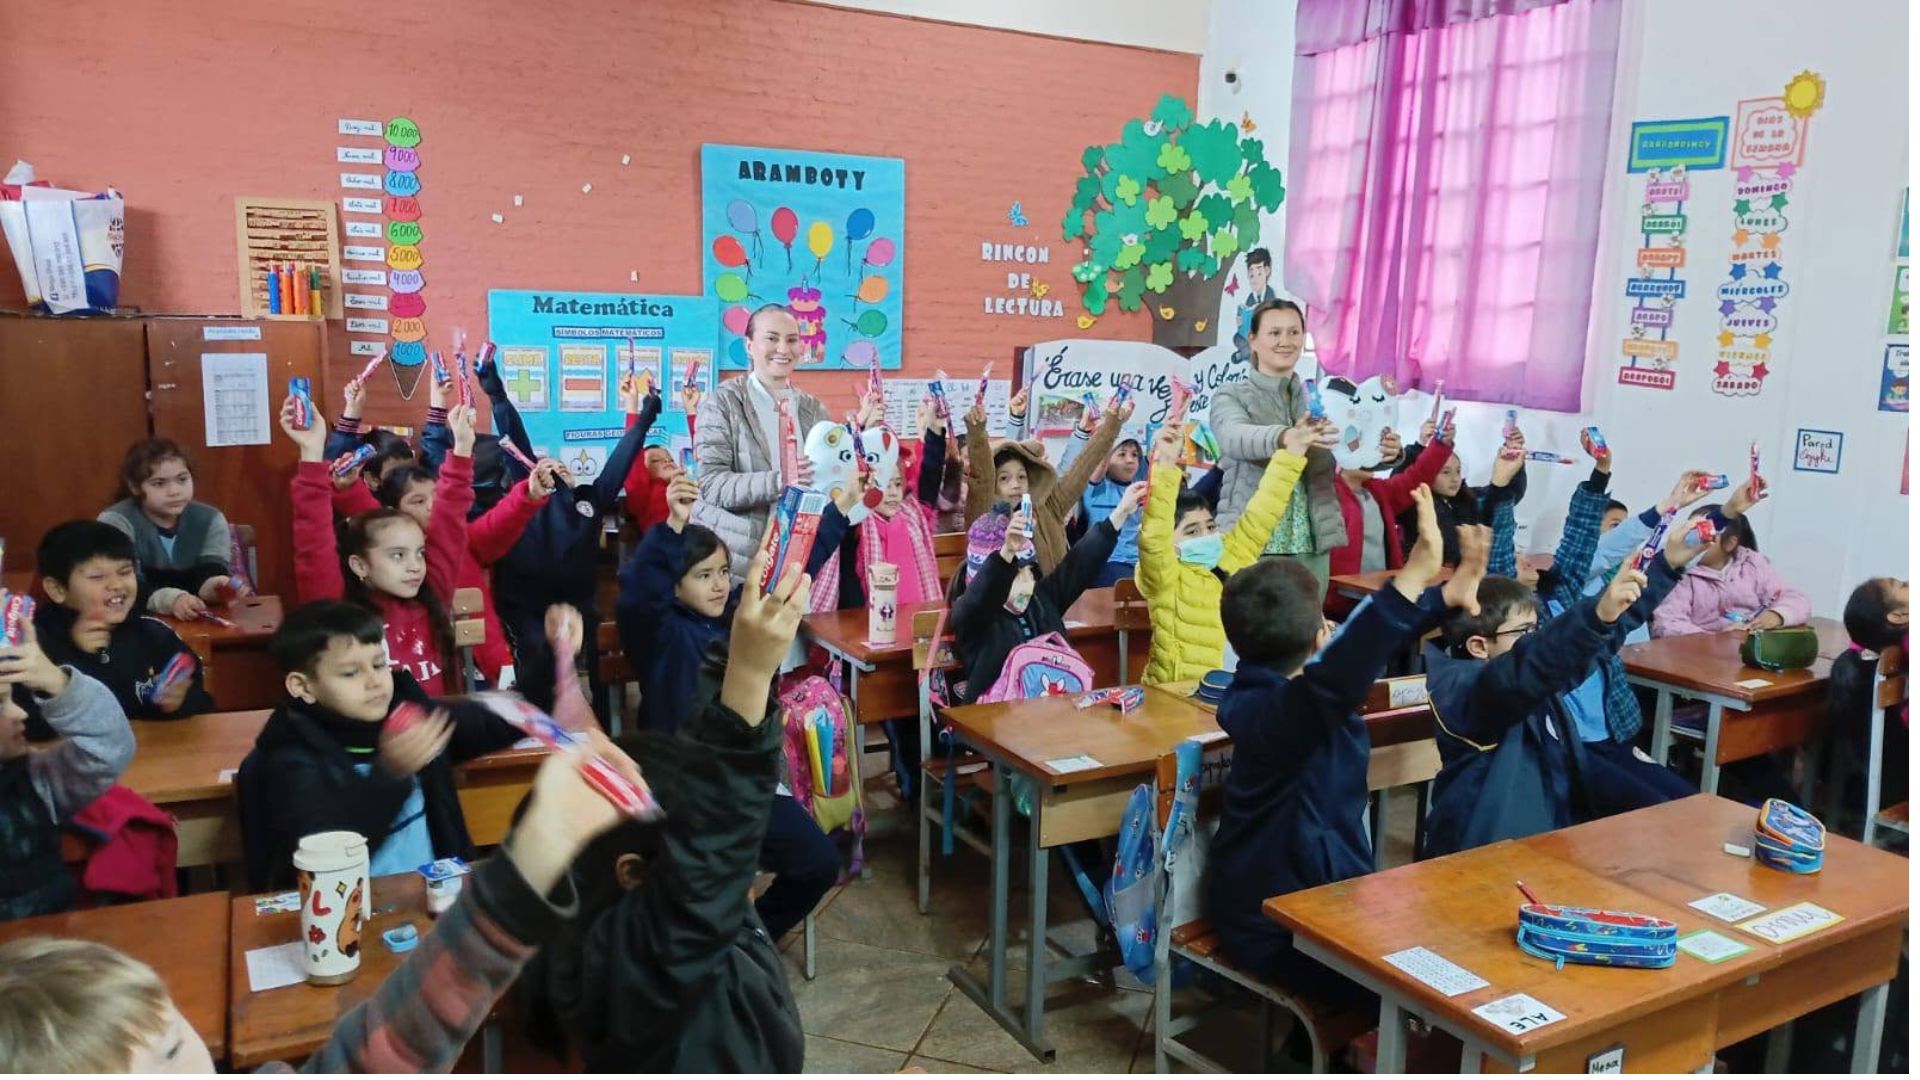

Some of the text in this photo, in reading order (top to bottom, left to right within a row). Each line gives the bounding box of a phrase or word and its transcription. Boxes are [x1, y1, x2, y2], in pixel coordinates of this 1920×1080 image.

[738, 160, 865, 190] ARAMBOTY
[1737, 183, 1788, 195] DOMINGO
[1740, 218, 1777, 226] LUNES
[982, 242, 1049, 263] RINCON
[1732, 250, 1777, 261] MARTES
[1008, 272, 1031, 289] DE
[532, 296, 674, 317] Matemática
[984, 297, 1064, 317] LECTURA
[1726, 319, 1769, 327] JUEVES
[1110, 372, 1144, 392] una
[1510, 1012, 1548, 1030] ALE
